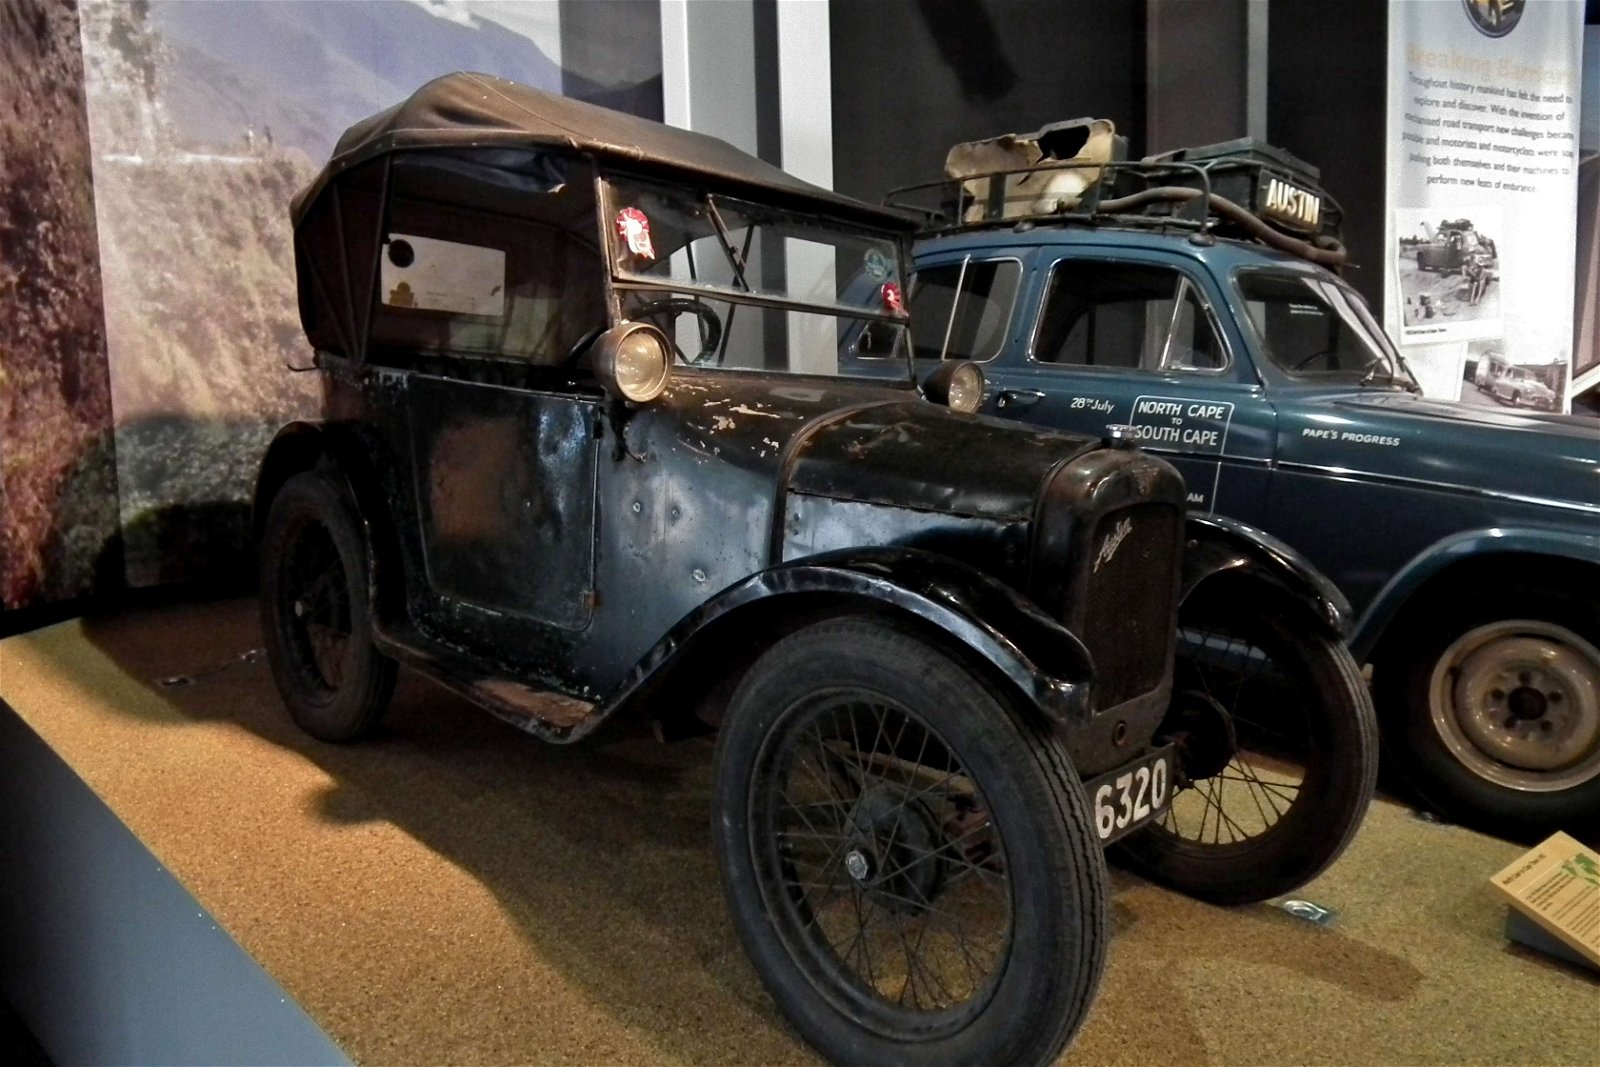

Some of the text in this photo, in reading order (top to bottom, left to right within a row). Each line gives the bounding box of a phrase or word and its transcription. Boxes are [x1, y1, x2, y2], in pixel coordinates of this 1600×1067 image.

[1450, 80, 1475, 93] history
[1507, 89, 1517, 98] has
[1529, 92, 1540, 101] the
[1543, 93, 1563, 102] need
[1442, 99, 1456, 108] and
[1491, 104, 1508, 115] With
[1509, 107, 1519, 117] the
[1556, 111, 1565, 120] of
[1443, 117, 1460, 128] road
[1511, 126, 1543, 140] challenges
[1426, 136, 1439, 145] and
[1442, 138, 1477, 149] motorists
[1479, 141, 1491, 150] and
[1433, 156, 1451, 165] both
[1493, 162, 1505, 171] and
[1523, 167, 1558, 175] machines
[1426, 175, 1458, 185] perform
[1494, 180, 1501, 188] of
[1266, 178, 1320, 224] AUSTIN
[1091, 399, 1115, 414] July
[1138, 401, 1225, 419] NORTH CAPE
[1171, 417, 1183, 425] TO
[1135, 425, 1219, 446] SOUTH CAPE
[1302, 428, 1401, 447] PAPE'S PROGRESS
[1095, 758, 1167, 839] 6320
